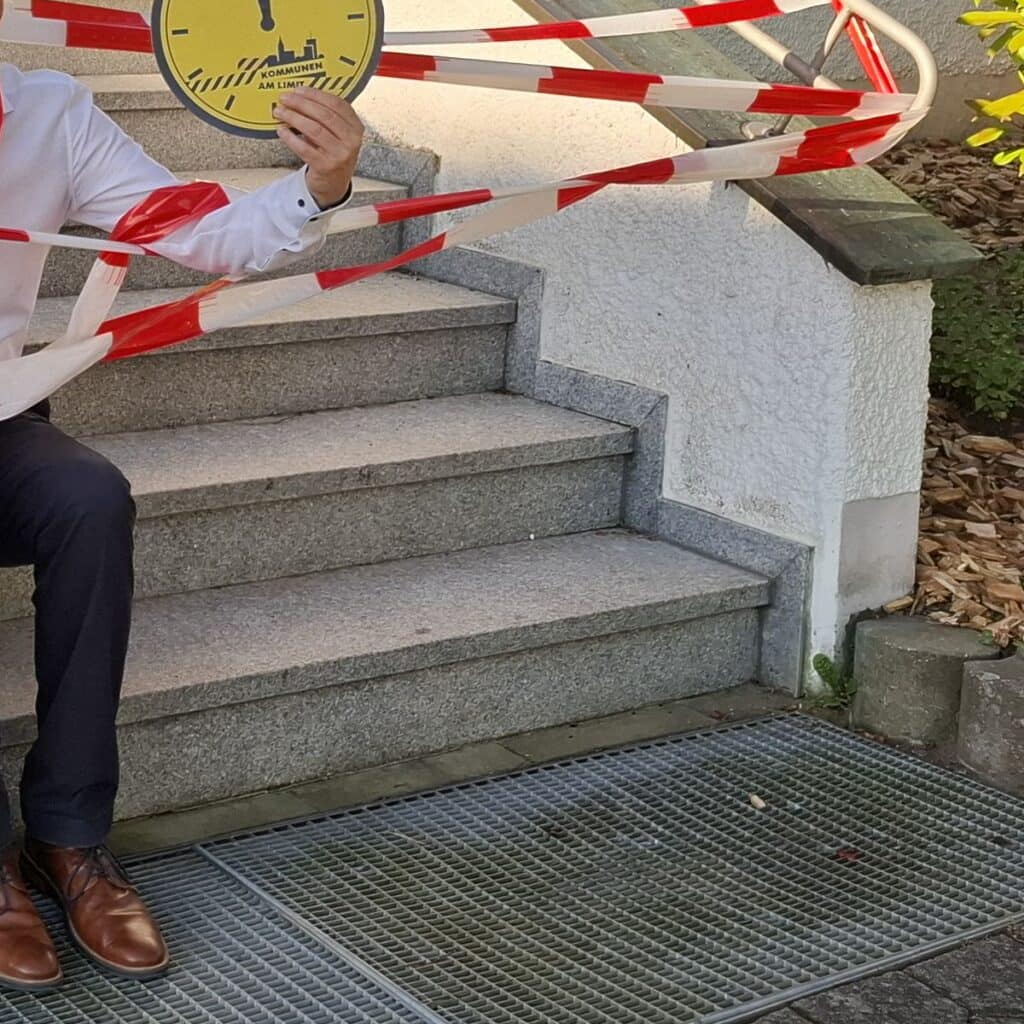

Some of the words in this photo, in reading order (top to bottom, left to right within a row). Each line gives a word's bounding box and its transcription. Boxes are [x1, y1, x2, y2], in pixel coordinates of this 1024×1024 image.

[261, 62, 323, 78] KOMMUNEN
[258, 81, 275, 89] AM
[277, 80, 304, 89] LIMIT
